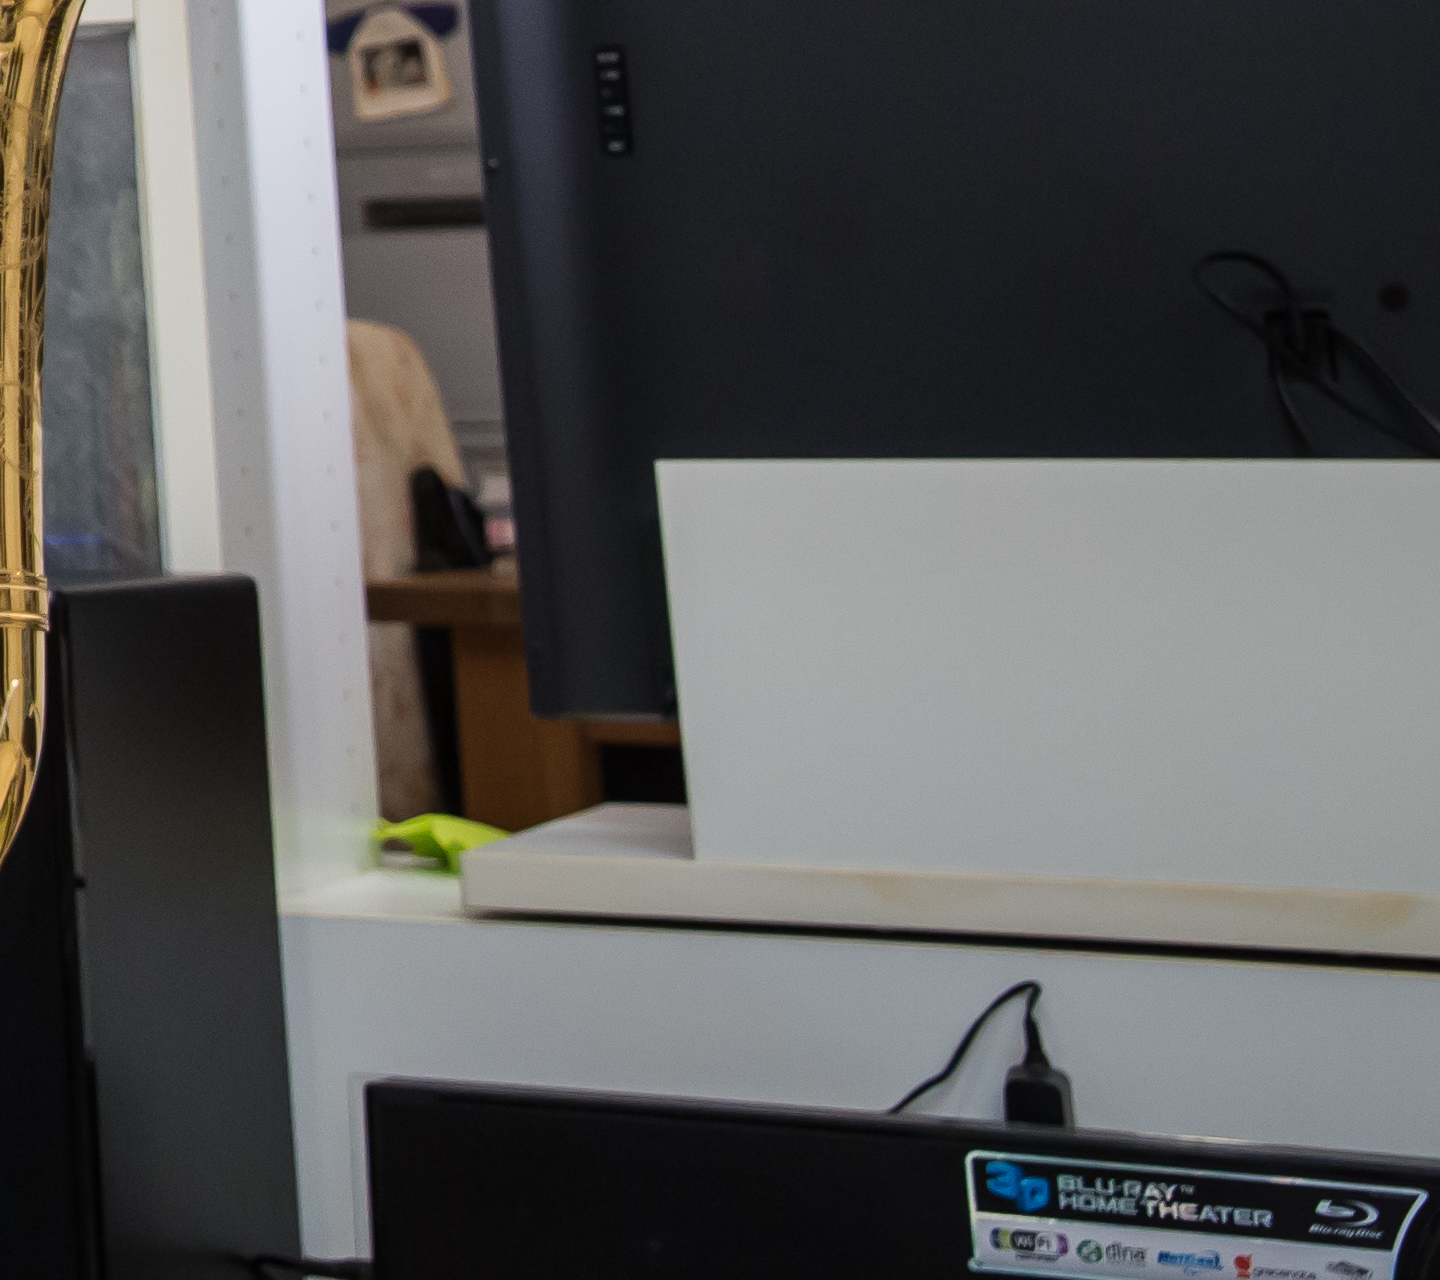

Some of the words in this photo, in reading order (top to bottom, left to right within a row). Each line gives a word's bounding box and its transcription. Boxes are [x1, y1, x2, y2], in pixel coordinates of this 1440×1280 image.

[986, 1161, 1052, 1213] 3D
[1058, 1192, 1139, 1217] HOME
[1146, 1198, 1274, 1228] THEATER
